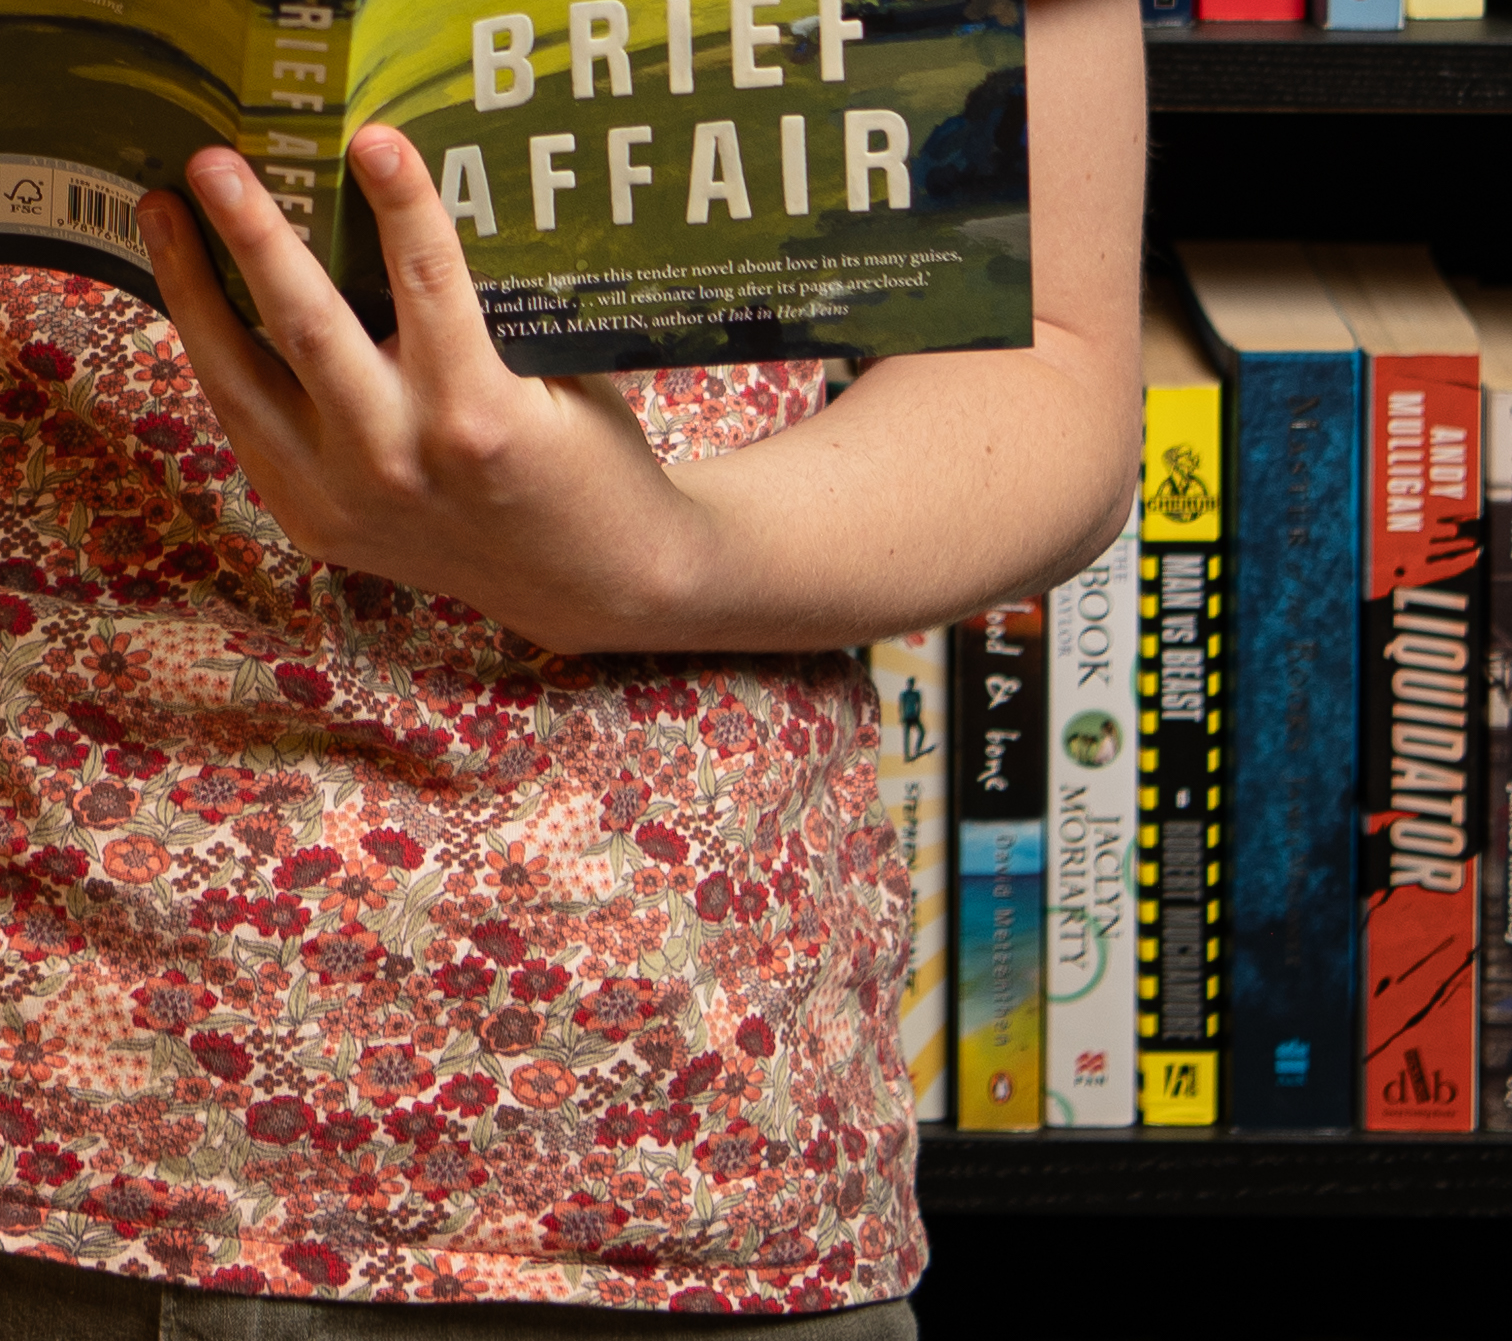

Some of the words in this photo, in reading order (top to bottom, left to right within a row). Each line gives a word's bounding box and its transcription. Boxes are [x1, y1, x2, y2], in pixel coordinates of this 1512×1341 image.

[10, 202, 42, 215] FSC
[440, 109, 911, 237] AFFAIR
[501, 275, 544, 294] ghost
[548, 269, 601, 291] haunts
[604, 265, 632, 283] this
[636, 263, 688, 281] tender
[692, 259, 734, 277] novel
[737, 257, 782, 274] about
[786, 253, 818, 271] love
[822, 253, 837, 269] in
[841, 251, 861, 268] its
[864, 249, 907, 270] many
[910, 247, 962, 269] guises,
[496, 319, 563, 339] SYLVIA
[567, 311, 648, 333] MARTIN,
[652, 309, 704, 328] author
[707, 306, 726, 323] of
[1387, 393, 1424, 534] MULLIGAN
[1430, 427, 1467, 501] ANDY
[1383, 588, 1471, 894] LIQUIDATOR
